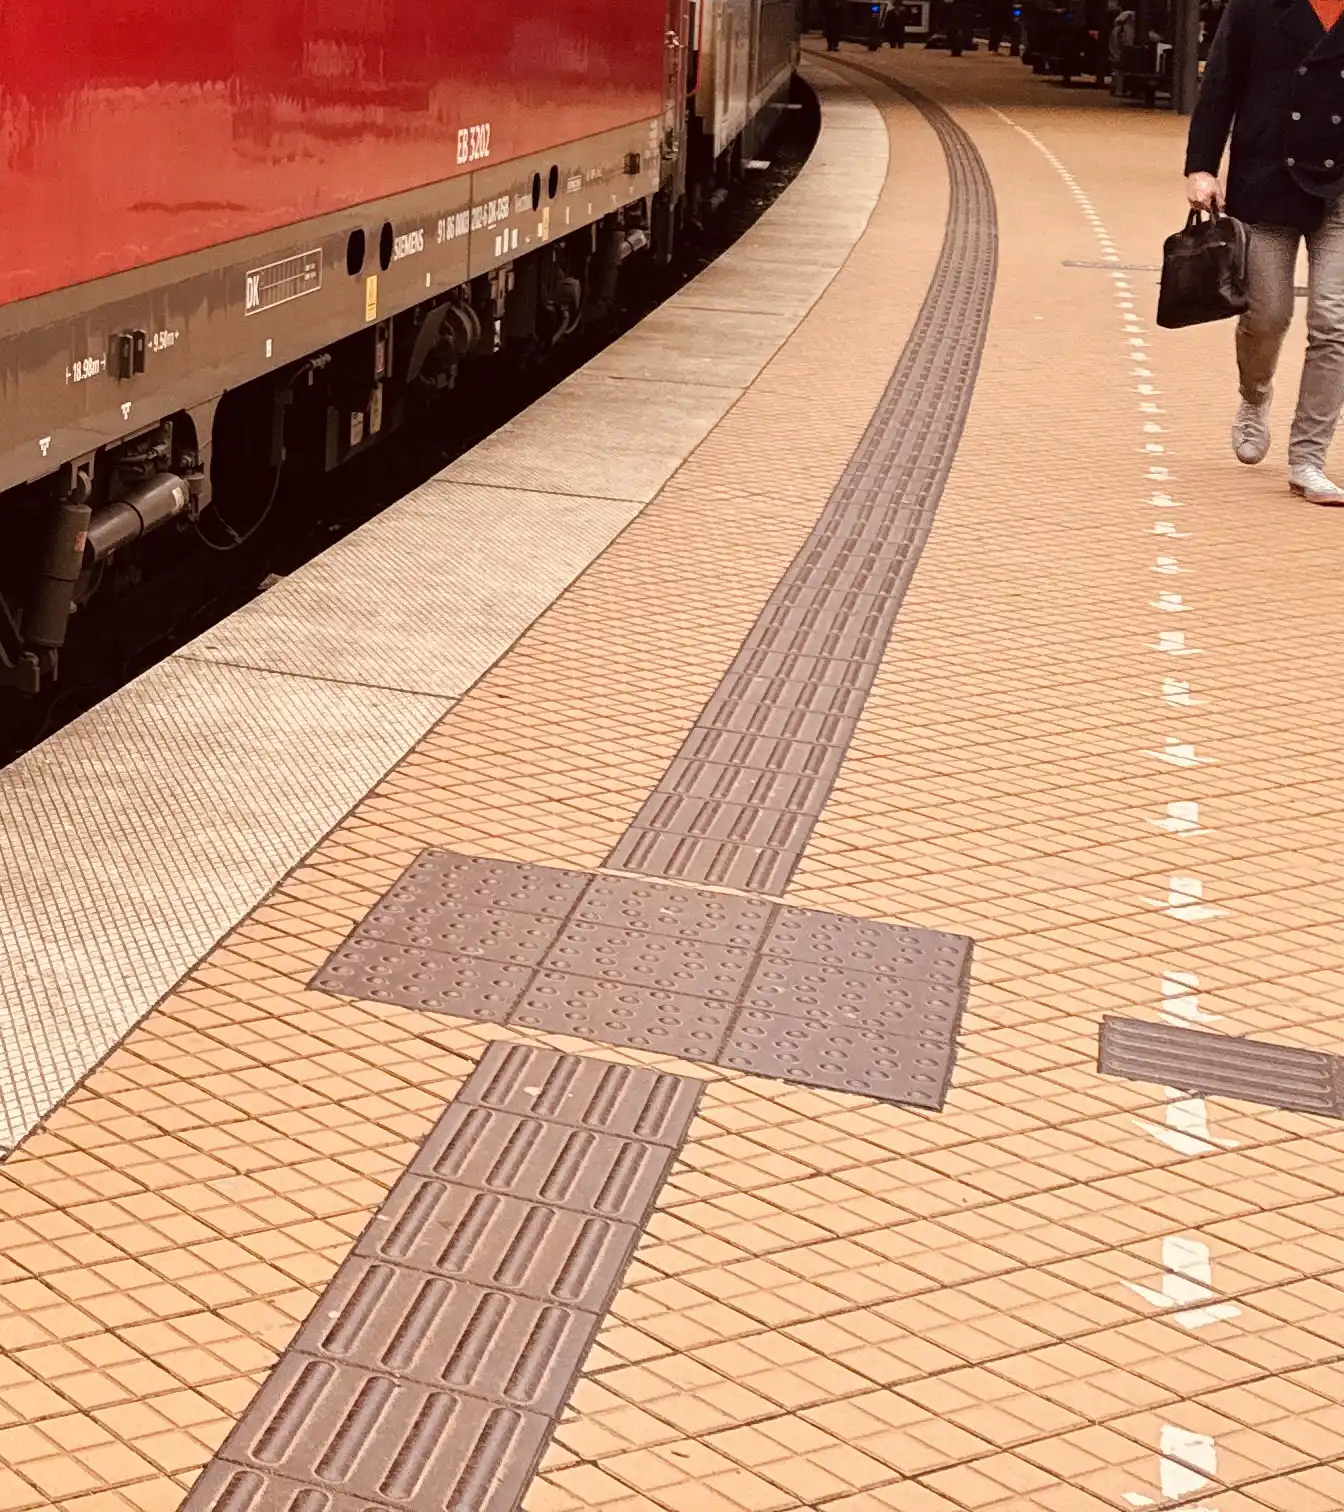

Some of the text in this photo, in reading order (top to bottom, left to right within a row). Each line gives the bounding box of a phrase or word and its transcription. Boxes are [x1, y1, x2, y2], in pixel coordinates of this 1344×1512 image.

[456, 123, 490, 165] EB 3202
[394, 228, 424, 261] SIEMENS
[247, 275, 261, 308] DK
